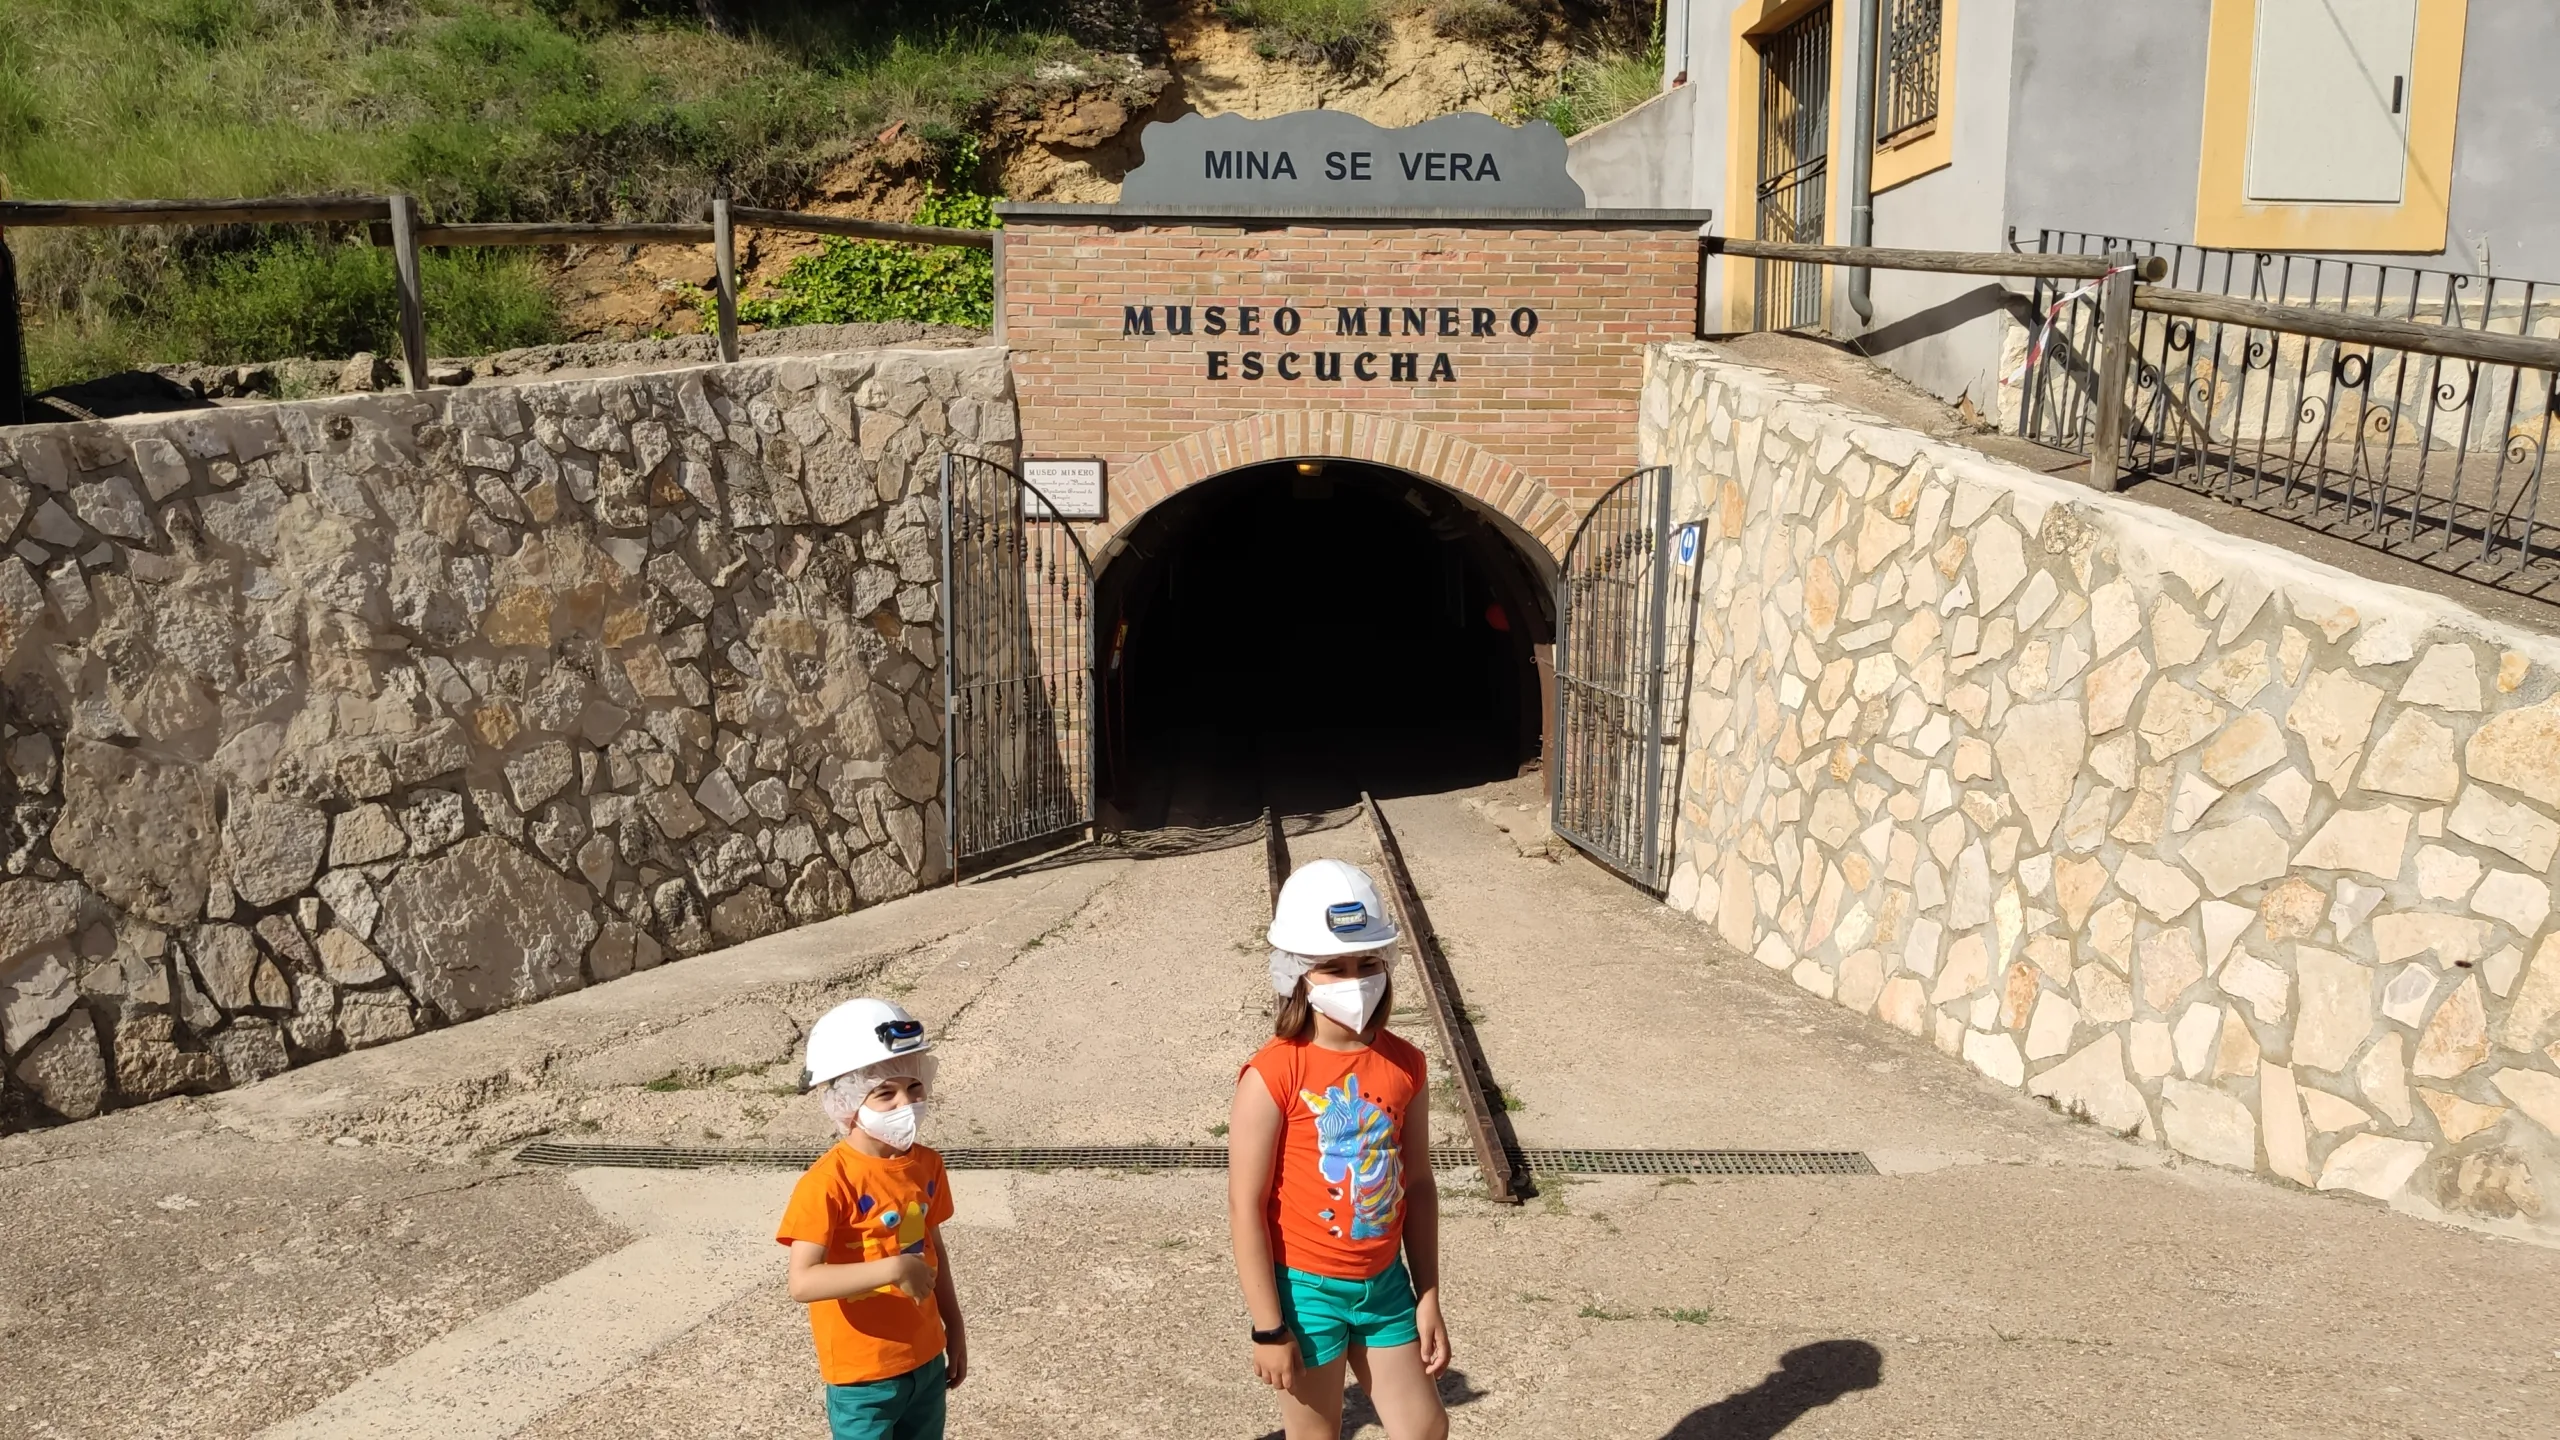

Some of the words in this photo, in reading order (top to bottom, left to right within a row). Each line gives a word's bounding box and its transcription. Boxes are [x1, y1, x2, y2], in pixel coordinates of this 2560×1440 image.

[1205, 150, 1298, 180] MINA
[1325, 151, 1373, 181] SE
[1398, 152, 1501, 182] VERA
[1123, 305, 1302, 336] MUSEO
[1335, 307, 1540, 338] MINERO
[1206, 351, 1457, 382] ESCUCHA
